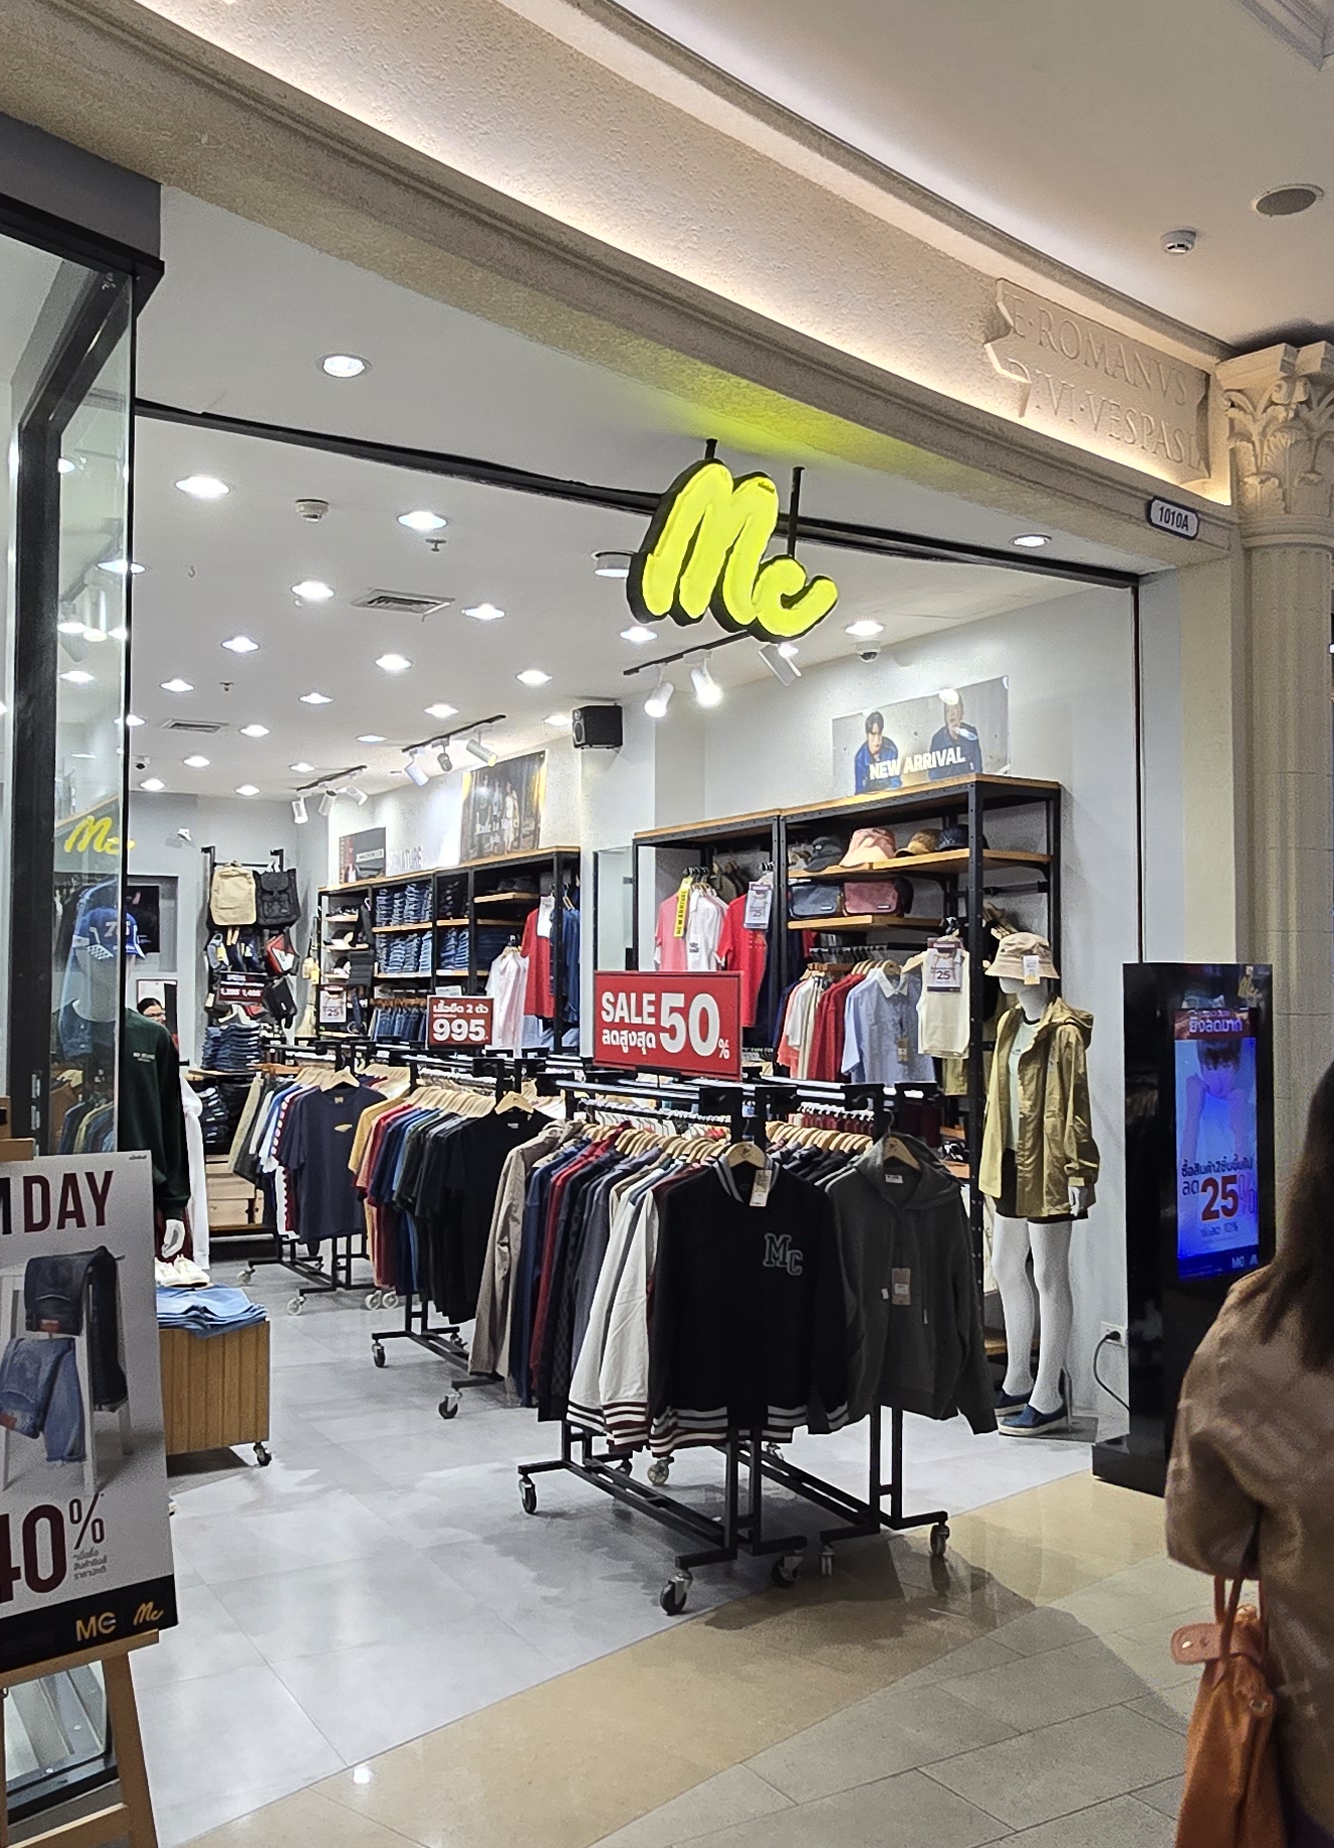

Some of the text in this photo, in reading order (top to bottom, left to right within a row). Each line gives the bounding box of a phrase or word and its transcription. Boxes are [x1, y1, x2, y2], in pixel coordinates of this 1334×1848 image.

[1158, 505, 1190, 532] 1010A
[635, 460, 839, 641] Mc
[869, 746, 966, 781] NEW ARRIVAL
[600, 991, 657, 1025] SALE
[601, 1028, 657, 1056] ลดสูงสุด
[22, 1169, 114, 1233] DAY
